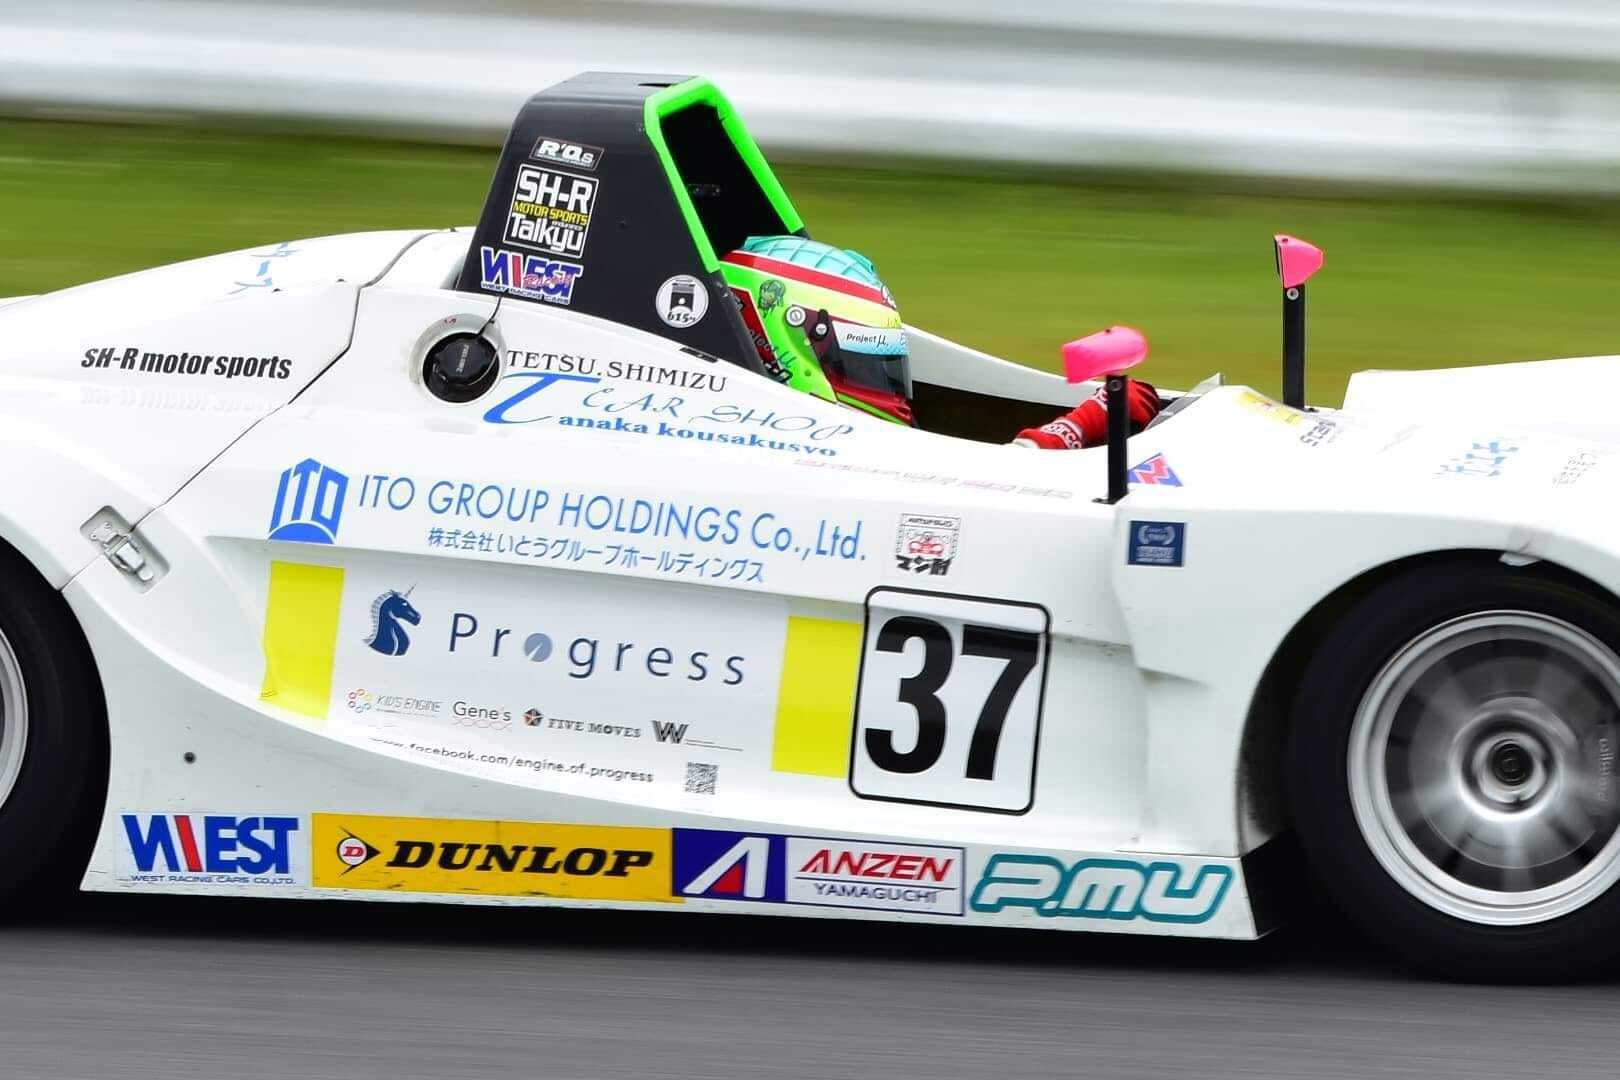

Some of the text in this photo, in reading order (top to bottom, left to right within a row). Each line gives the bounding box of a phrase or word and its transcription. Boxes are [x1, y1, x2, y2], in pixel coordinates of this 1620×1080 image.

[516, 170, 593, 214] SH-R
[513, 201, 588, 225] MOTOR SPORTS
[482, 247, 583, 299] WEST
[846, 332, 877, 344] Project
[81, 348, 139, 370] SH-R
[506, 350, 727, 393] TETSU.SHIMIZU
[358, 474, 416, 511] ITO
[427, 480, 549, 523] GROUP
[558, 492, 743, 545] HOLDINGS
[427, 526, 766, 583] 株式会社いとうグループホールディングス
[448, 612, 746, 687] Progress
[864, 614, 1040, 781] 37
[548, 717, 584, 732] FIVE
[121, 814, 299, 875] WEST
[386, 840, 655, 877] DUNLOP
[168, 875, 213, 884] RACING
[799, 848, 955, 882] ANZEN
[813, 882, 939, 905] YAMAGUCHI
